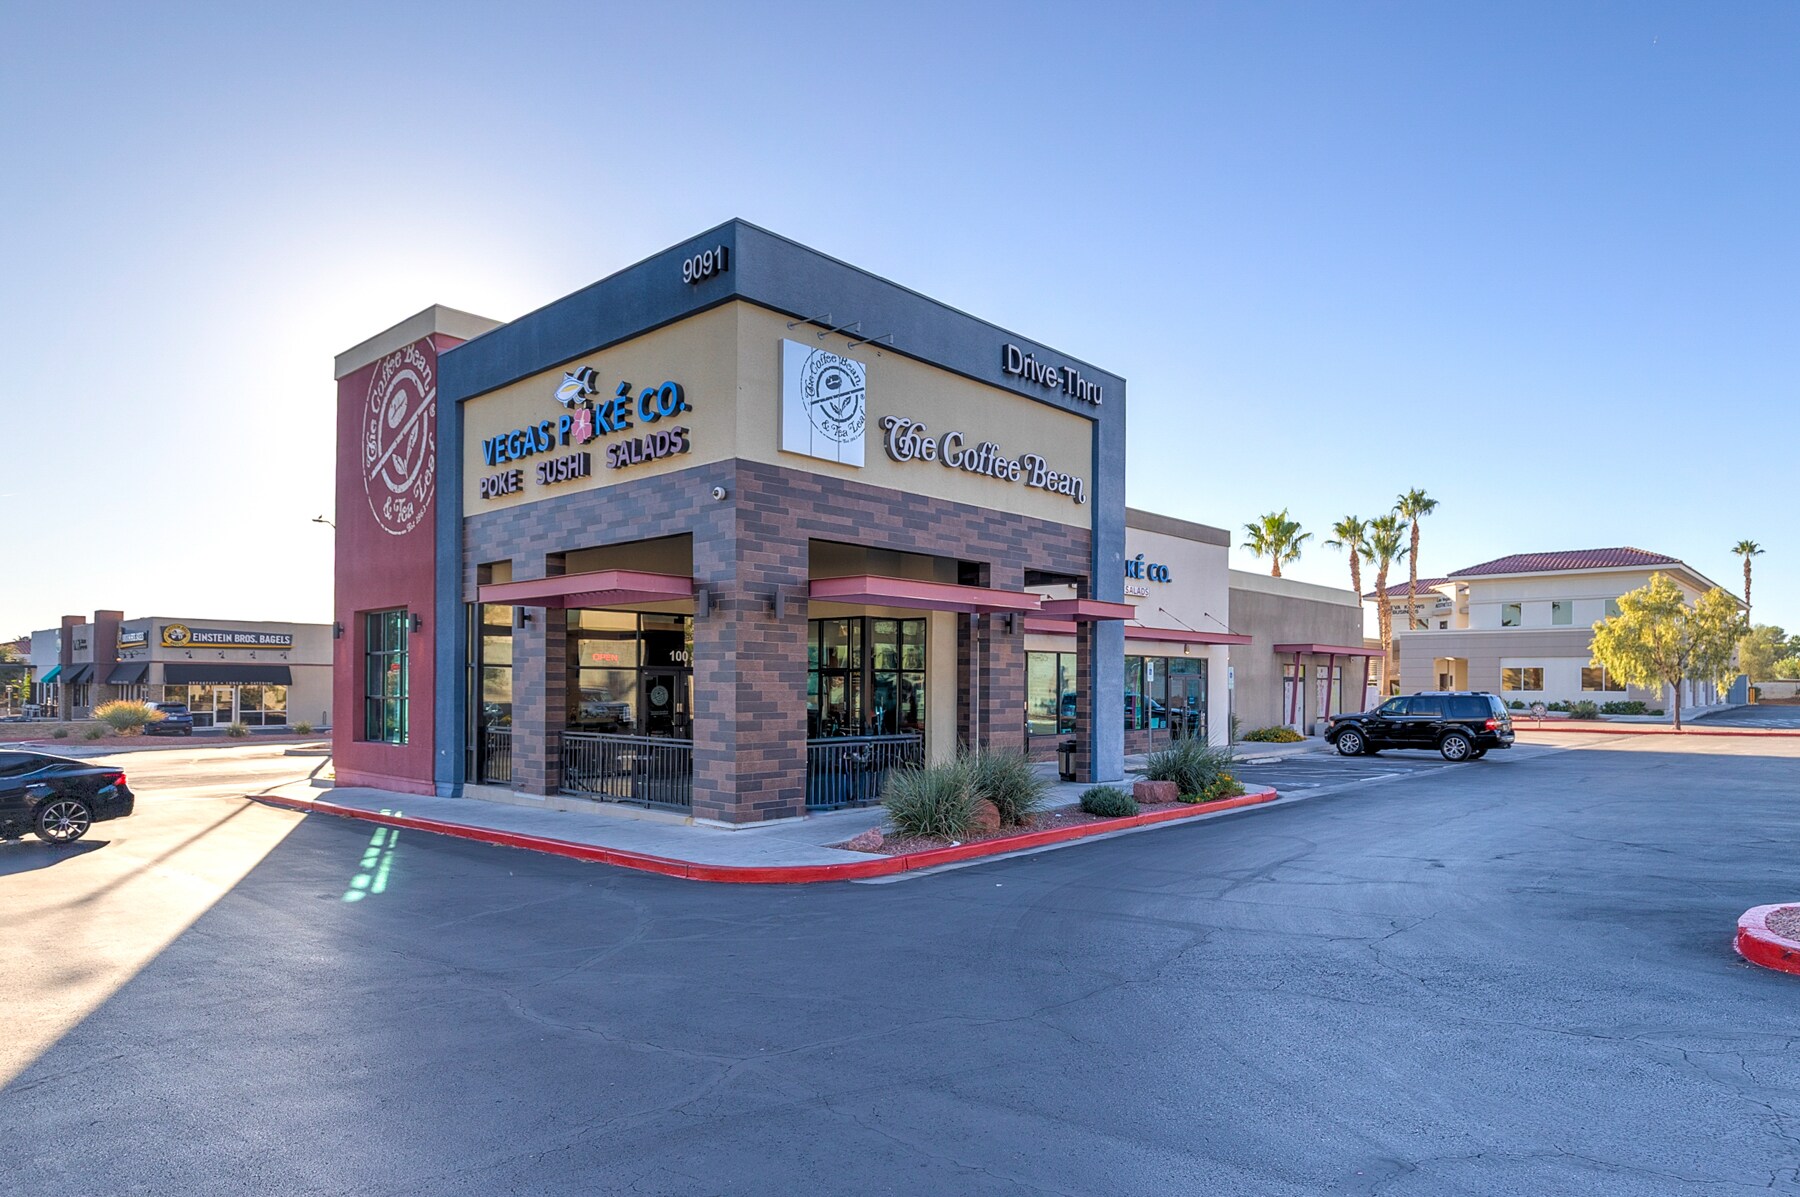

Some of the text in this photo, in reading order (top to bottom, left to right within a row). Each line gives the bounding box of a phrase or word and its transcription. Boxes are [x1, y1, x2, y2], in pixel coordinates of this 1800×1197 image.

[682, 244, 723, 284] 9091
[371, 350, 402, 412] Coffee
[401, 344, 434, 391] Bean
[809, 351, 837, 376] Coffee
[839, 355, 862, 387] Bean
[1003, 342, 1104, 406] Drive-Thru
[481, 419, 553, 467] VEGAS
[637, 380, 690, 423] CO.
[831, 424, 849, 438] Tea
[479, 425, 685, 499] POKE SUSHI SALADS
[882, 414, 1087, 505] The Coffee Bean
[393, 497, 415, 524] Tea
[1125, 585, 1150, 597] SALADS
[192, 632, 233, 643] EINSTEIN
[234, 633, 258, 644] BROS.
[259, 634, 291, 645] BAGELS
[668, 650, 689, 663] 100
[591, 652, 619, 663] OPEN
